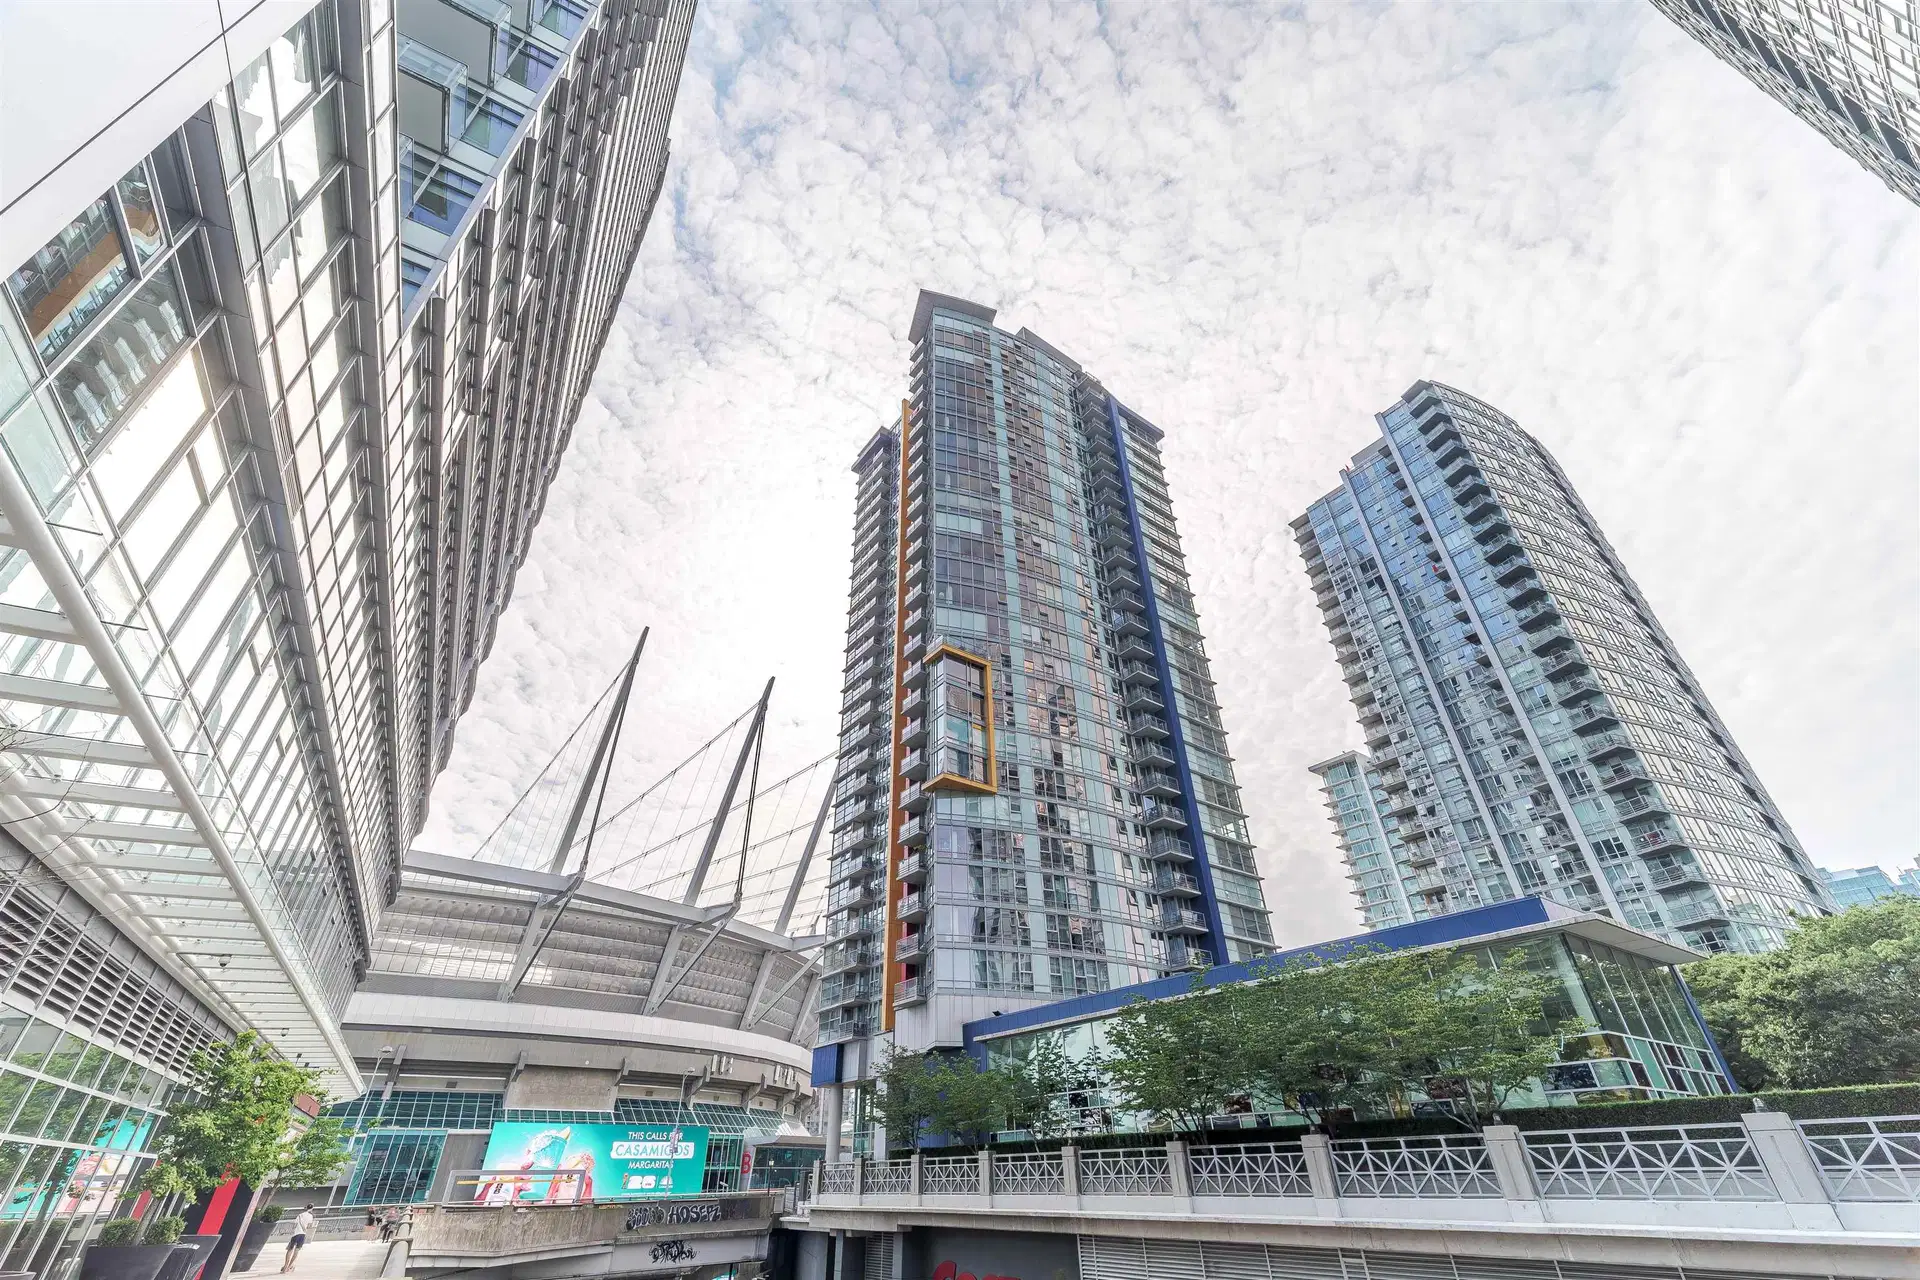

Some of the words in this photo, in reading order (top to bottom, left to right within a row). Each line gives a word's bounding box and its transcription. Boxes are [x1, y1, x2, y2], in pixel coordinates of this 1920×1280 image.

[628, 1131, 644, 1140] THIS
[645, 1131, 667, 1140] CALLS
[669, 1132, 683, 1140] FR
[628, 1160, 674, 1169] MARGARITAS
[741, 1152, 751, 1174] B
